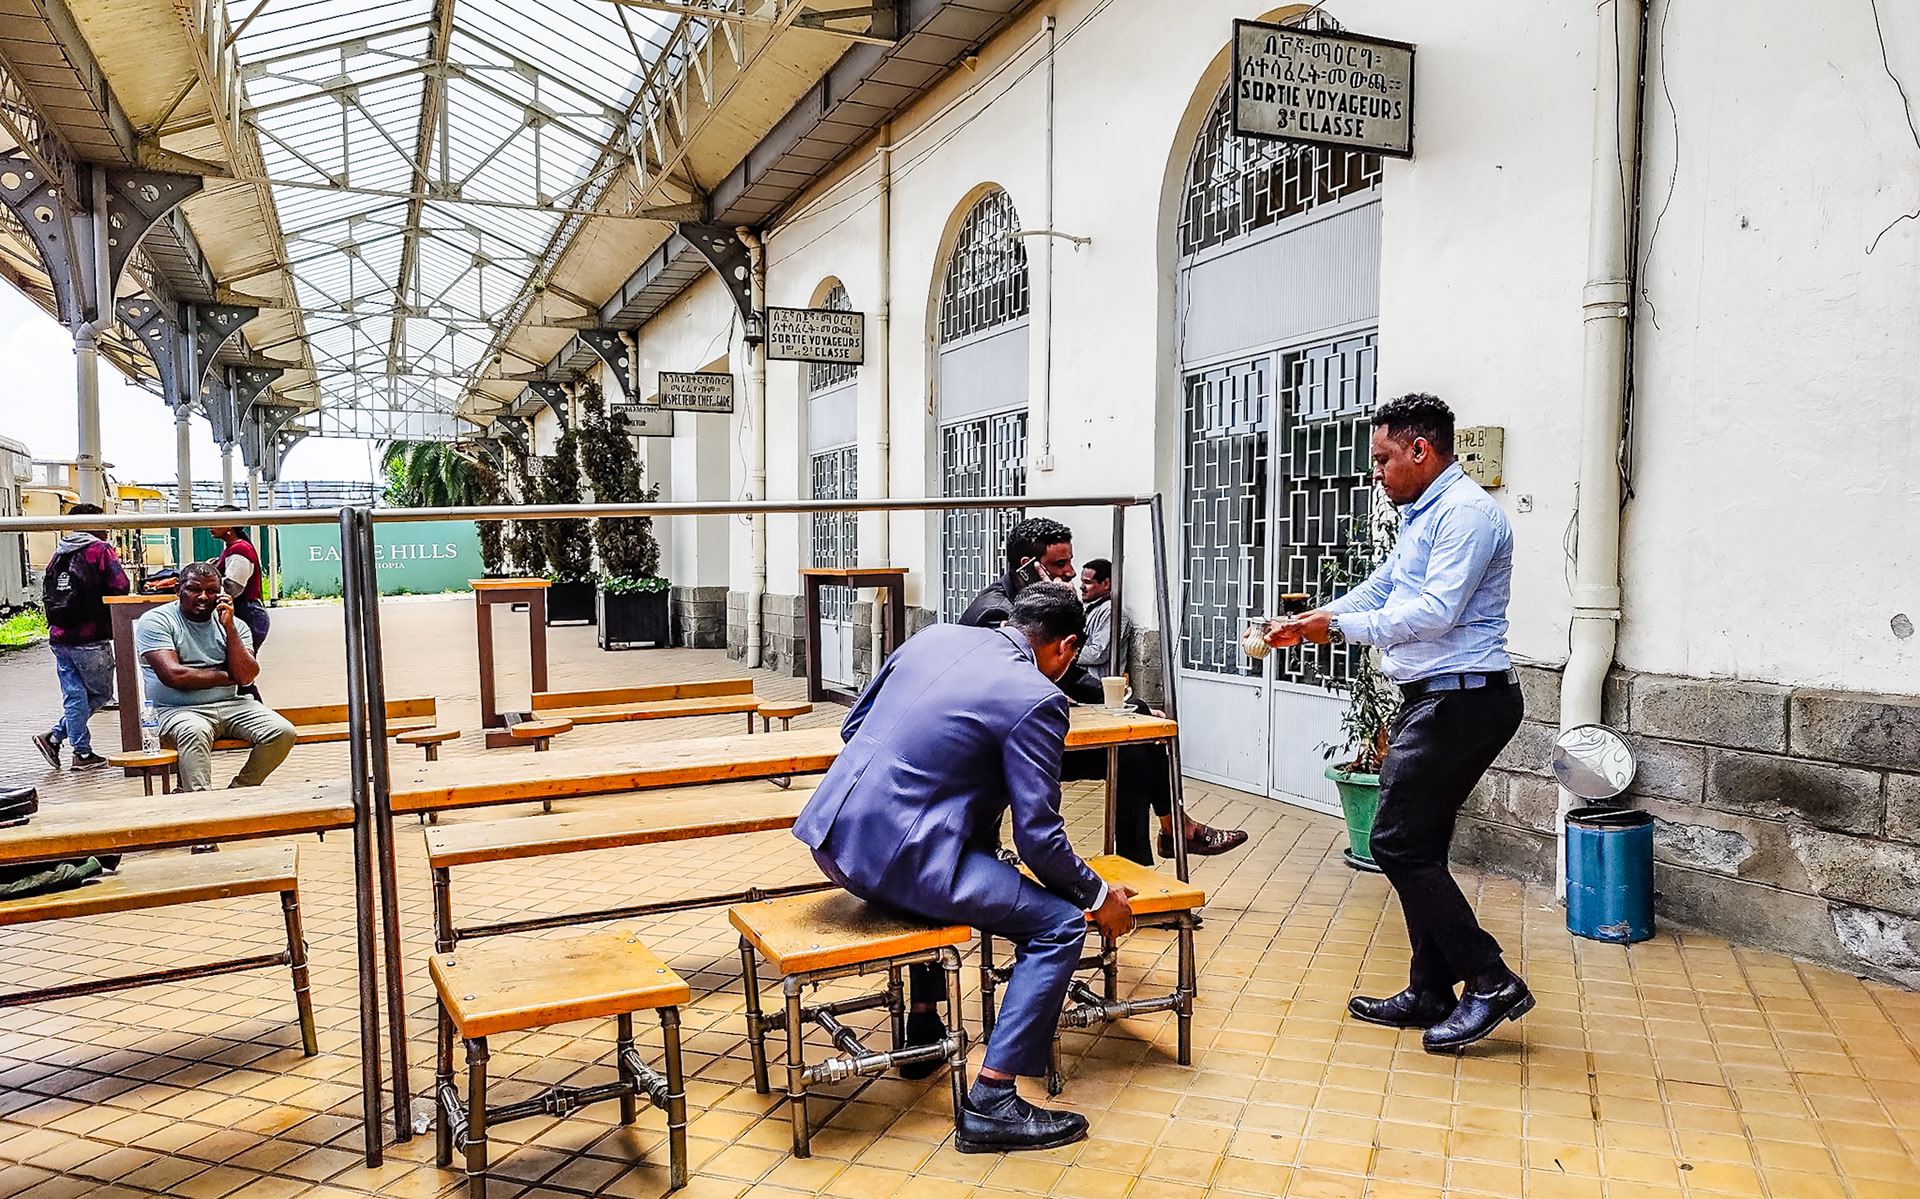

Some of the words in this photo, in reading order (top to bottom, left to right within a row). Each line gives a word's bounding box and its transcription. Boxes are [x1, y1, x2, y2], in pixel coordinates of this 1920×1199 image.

[1241, 80, 1300, 107] SORTIE
[1306, 88, 1402, 120] VOYAGEURS
[1299, 112, 1365, 139] CLASSE
[771, 333, 806, 345] SORTIE
[809, 335, 860, 348] VOYAGEURS
[815, 347, 850, 358] CLASSE
[661, 393, 697, 406] INSPECTEUR
[698, 394, 712, 407] CHEF
[309, 545, 384, 562] EAE
[391, 543, 458, 560] HILLS
[374, 561, 406, 570] IOPIA
